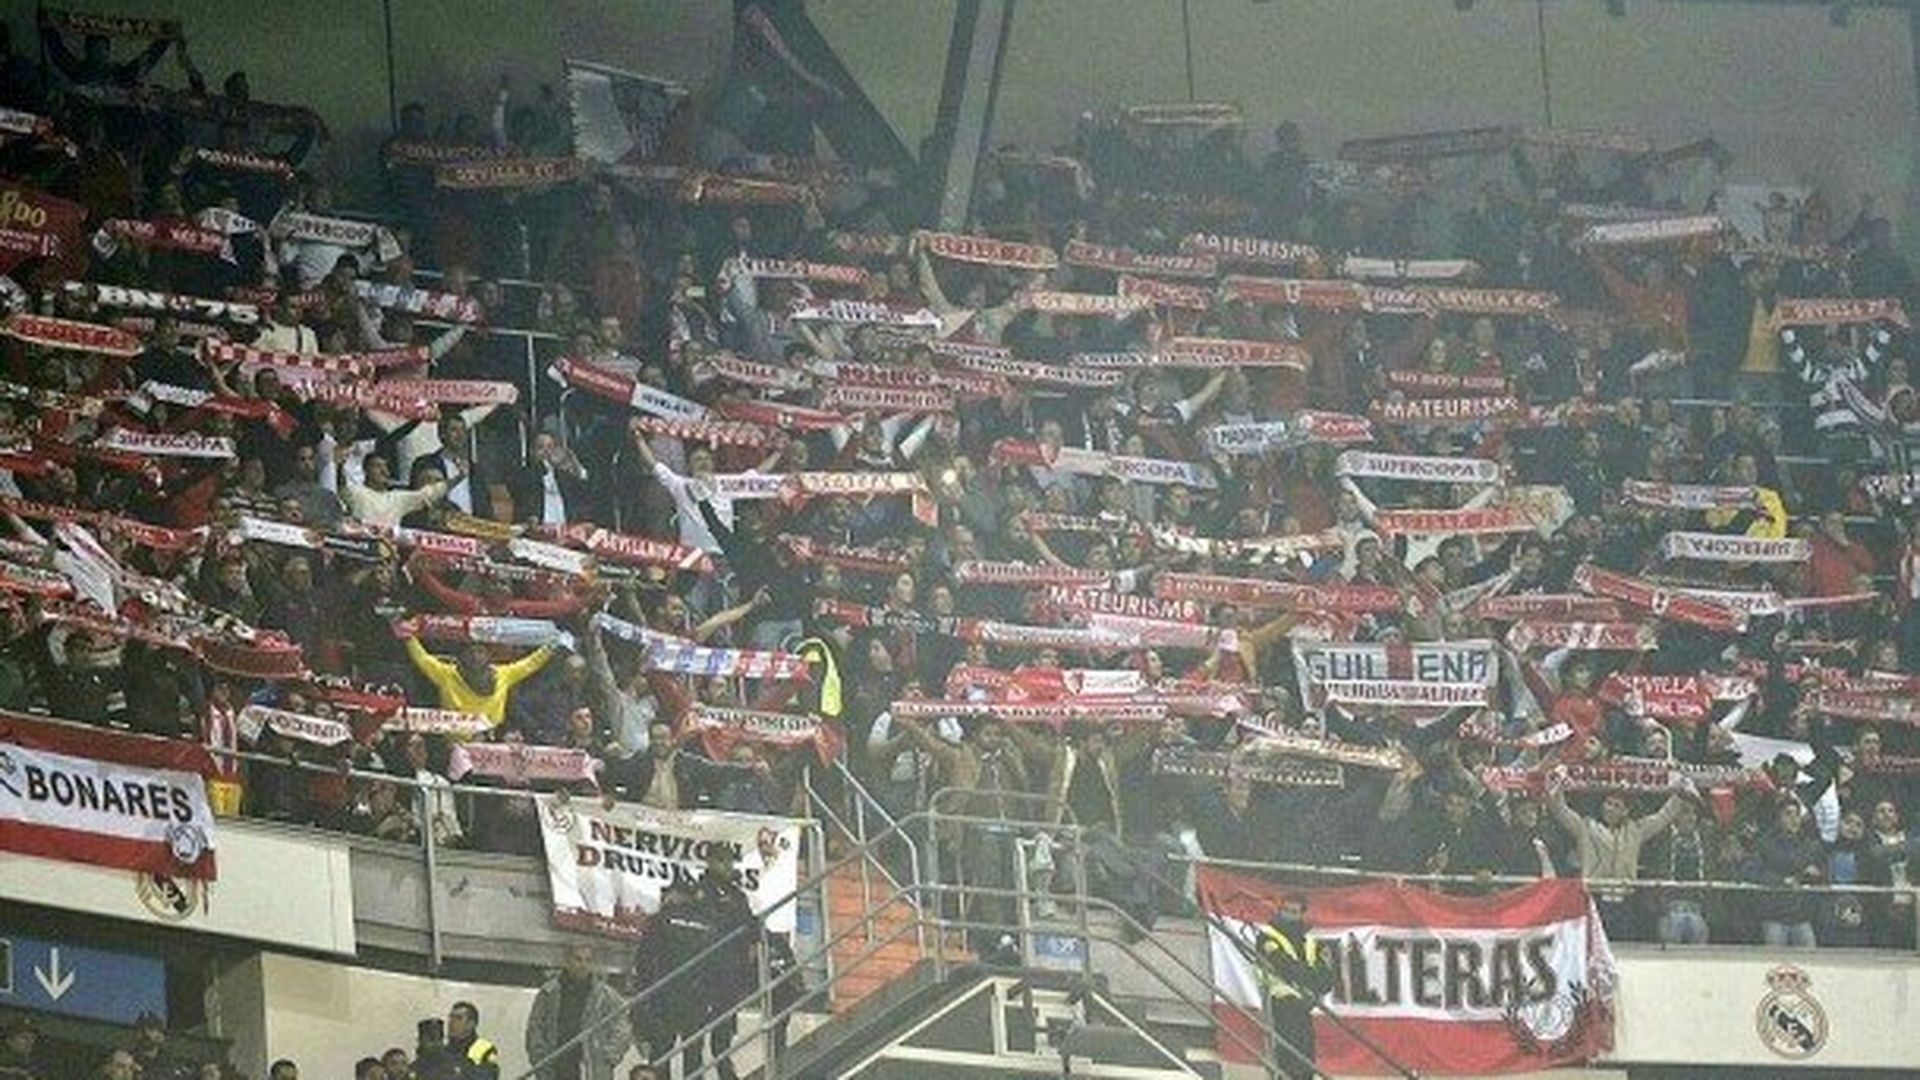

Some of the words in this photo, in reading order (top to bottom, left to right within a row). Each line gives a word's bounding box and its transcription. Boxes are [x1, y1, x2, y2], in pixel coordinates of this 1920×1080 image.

[1367, 458, 1476, 477] SUPERCOPA
[1309, 651, 1487, 682] GUILENA
[25, 764, 194, 823] BONARES
